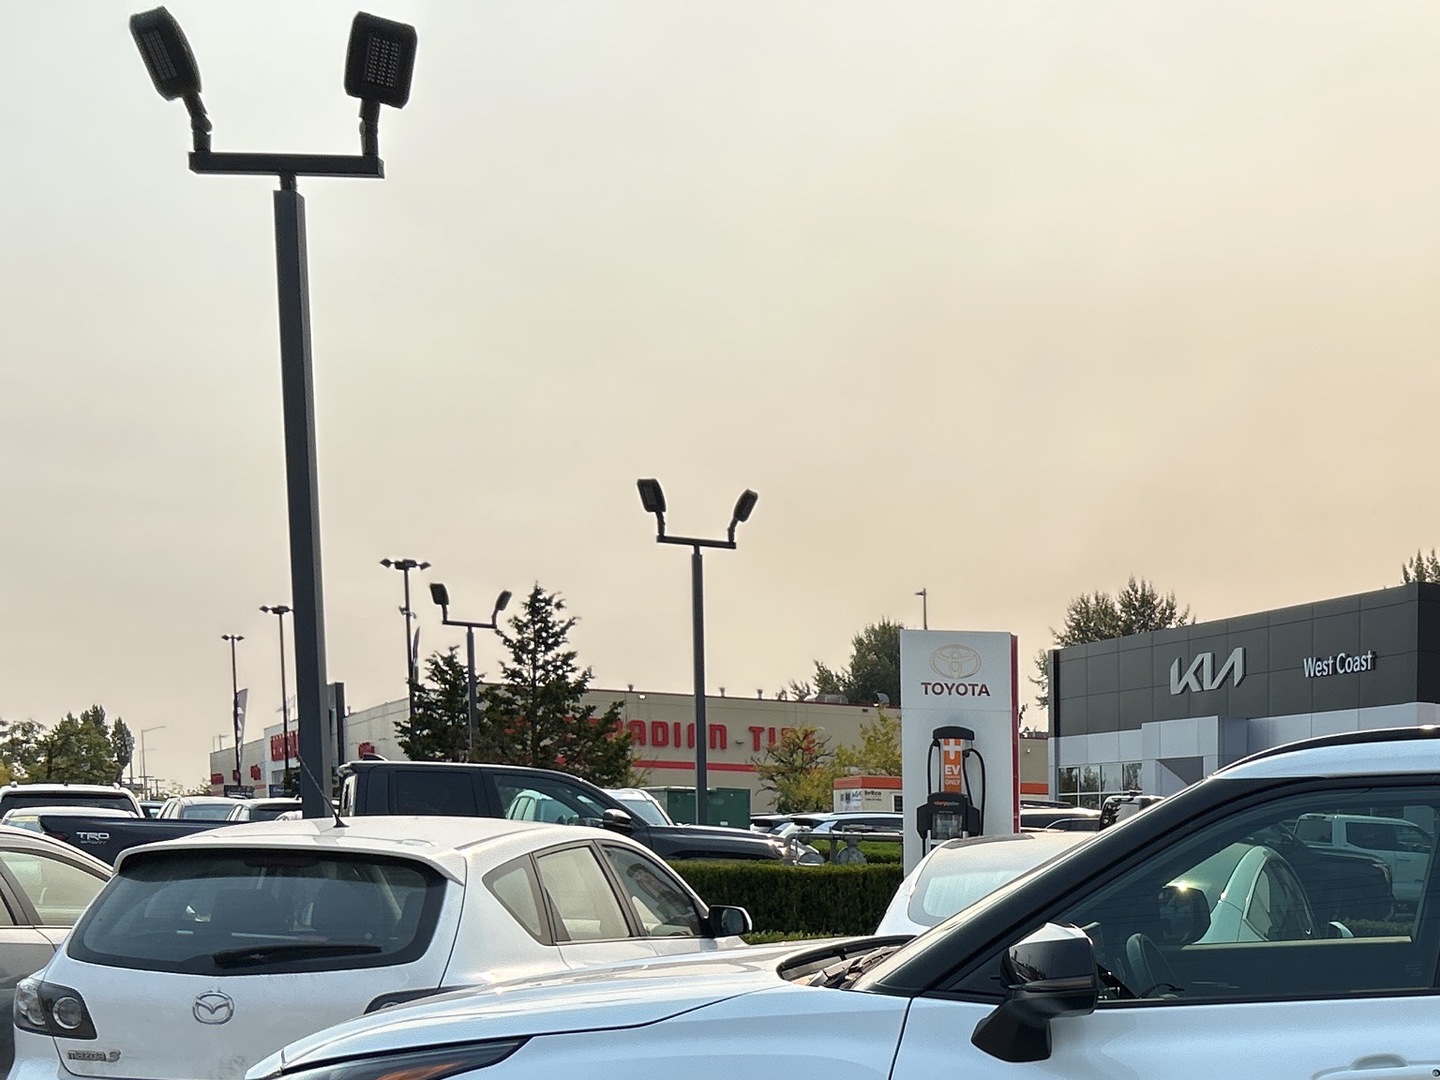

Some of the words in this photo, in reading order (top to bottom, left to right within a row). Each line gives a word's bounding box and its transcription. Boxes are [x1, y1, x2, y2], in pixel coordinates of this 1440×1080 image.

[1170, 647, 1246, 695] KIA
[1303, 656, 1334, 678] West
[1336, 650, 1373, 674] Coast
[921, 682, 991, 697] TOYOTA
[944, 764, 960, 775] EV
[76, 831, 110, 841] TRD
